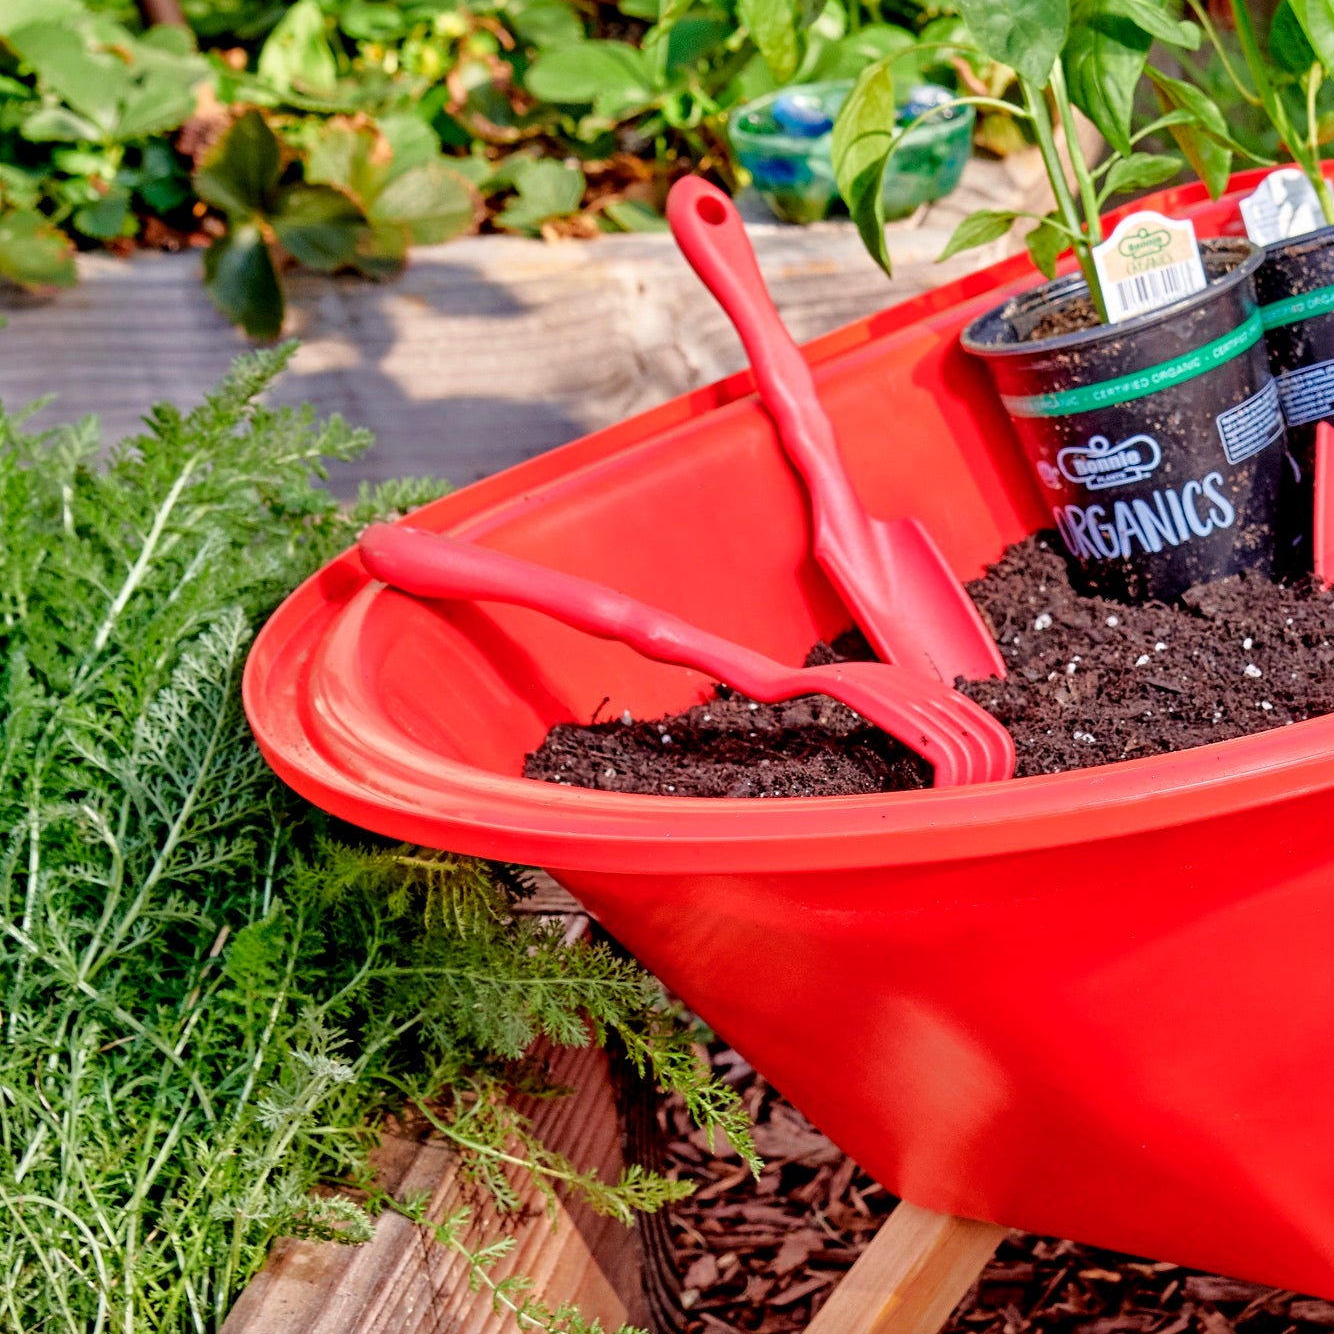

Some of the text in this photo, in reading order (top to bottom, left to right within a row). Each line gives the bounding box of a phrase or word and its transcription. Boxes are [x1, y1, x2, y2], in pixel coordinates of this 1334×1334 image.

[1093, 356, 1200, 402] CERTIFIED ORGANIC
[1071, 449, 1142, 476] Bonnie
[1052, 471, 1236, 561] ORGANICS
